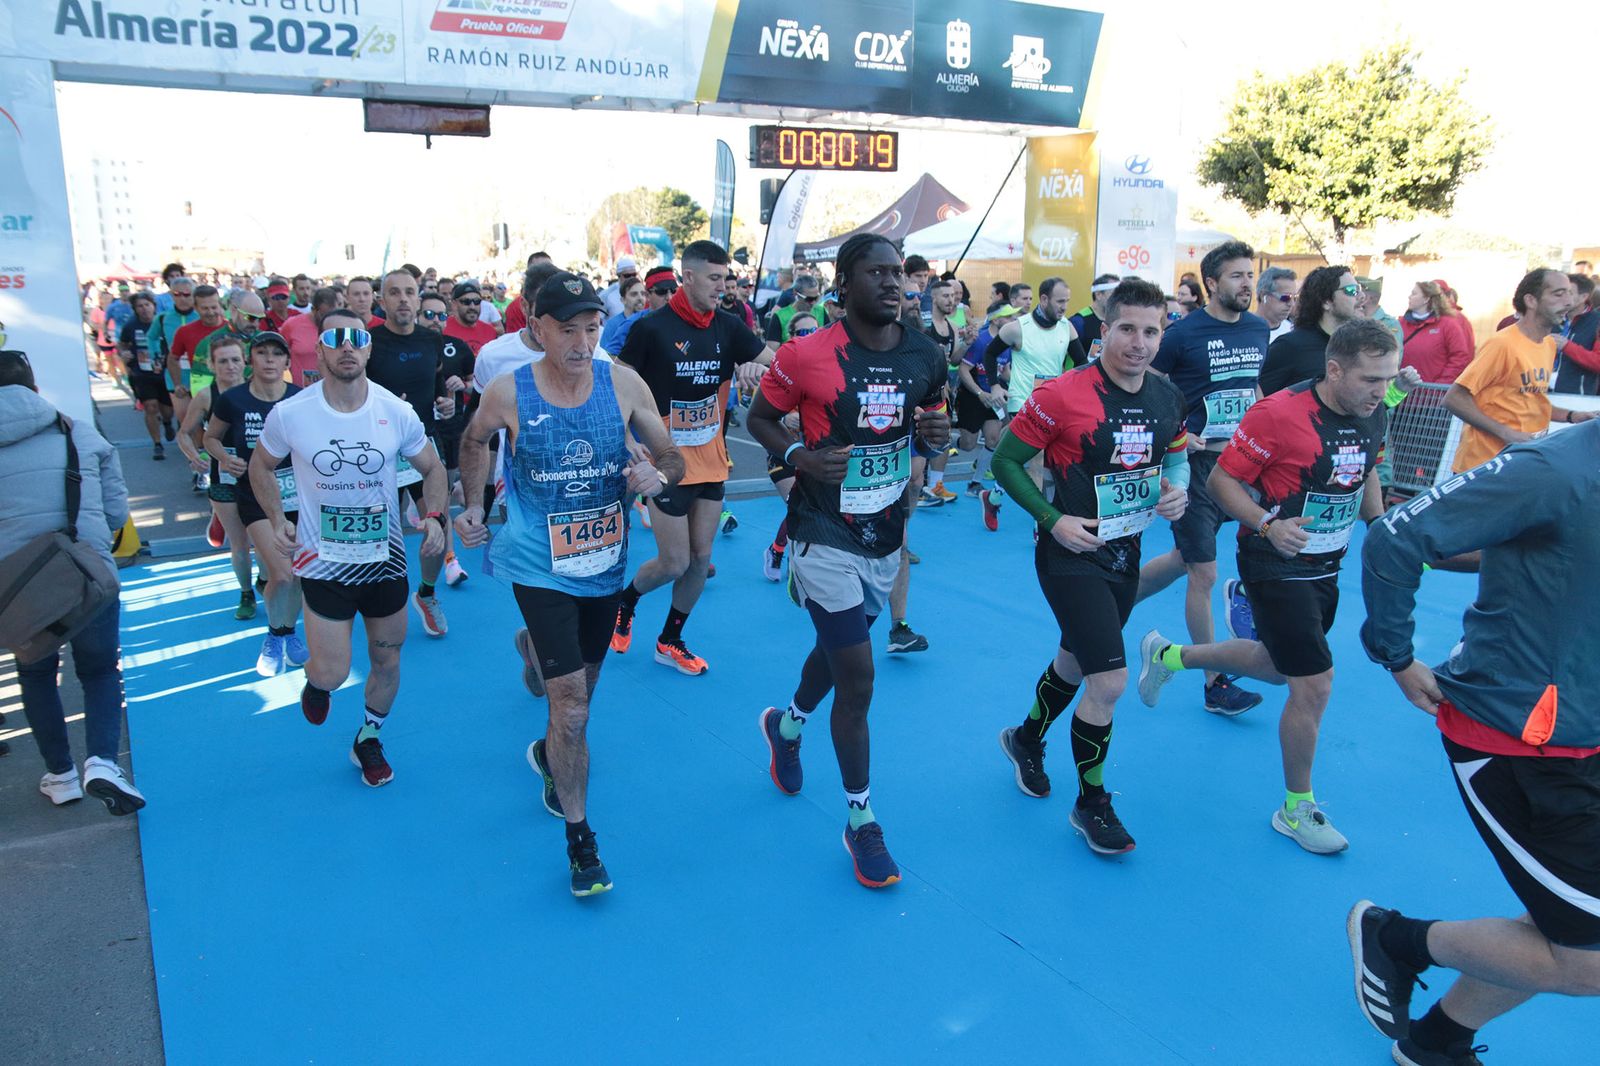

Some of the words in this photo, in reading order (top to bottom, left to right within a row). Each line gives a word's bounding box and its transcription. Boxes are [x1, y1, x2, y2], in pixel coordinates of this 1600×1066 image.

[54, 0, 238, 49] Almería
[460, 18, 503, 32] Prueba
[506, 22, 545, 35] Oficial
[759, 25, 830, 62] NEXA
[854, 30, 913, 64] CDX
[428, 46, 508, 67] RAMÓN
[518, 55, 567, 72] RUIZ
[575, 57, 670, 79] ANDÚJAR
[936, 72, 980, 87] ALMERÍA
[947, 84, 970, 93] CIUDAD
[1039, 169, 1085, 199] NEXA
[1113, 177, 1164, 189] HYUNDAI
[1117, 219, 1155, 228] ESTRELLA
[1040, 232, 1079, 260] CDX
[1117, 245, 1150, 270] ego
[1208, 348, 1230, 358] Medio
[1209, 355, 1241, 367] Almería
[773, 360, 794, 385] fuerte
[857, 392, 906, 407] TEAM
[1214, 398, 1251, 415] 1518
[678, 405, 715, 422] 1367
[1112, 431, 1154, 444] TEAM
[1248, 437, 1271, 459] fuerte
[859, 452, 900, 478] 831
[1331, 452, 1367, 466] TEAM
[531, 468, 577, 483] Carboneras
[579, 465, 600, 479] sabe
[316, 481, 355, 491] cousins
[358, 480, 384, 490] bikes
[1111, 479, 1150, 505] 390
[1319, 501, 1356, 522] 419
[327, 514, 383, 533] 1235
[560, 515, 618, 545] 1464
[575, 539, 604, 550] CAYUELA
